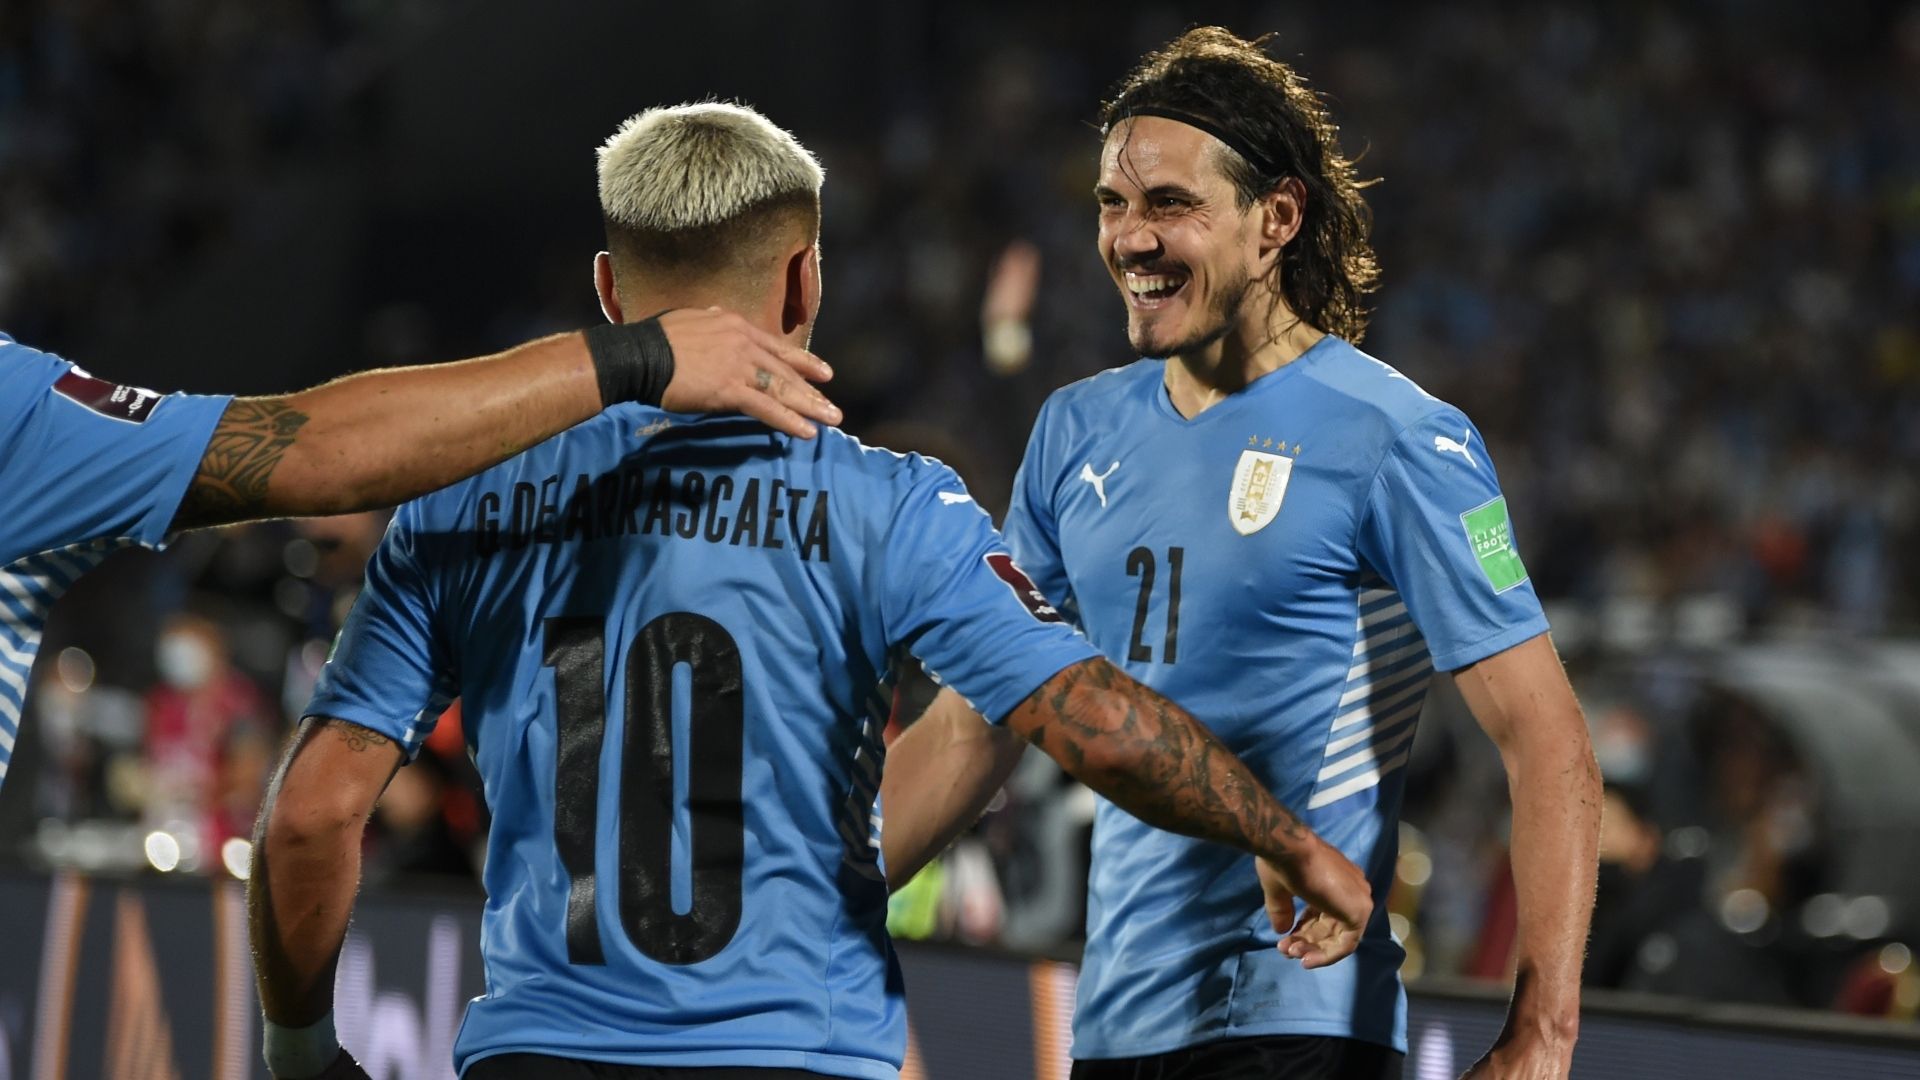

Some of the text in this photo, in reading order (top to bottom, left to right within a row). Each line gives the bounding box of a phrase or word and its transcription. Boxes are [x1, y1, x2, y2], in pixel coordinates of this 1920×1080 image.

[511, 474, 559, 550] DE
[563, 466, 830, 562] ARRASCAETA
[1126, 546, 1184, 664] 21
[542, 611, 744, 965] 10
